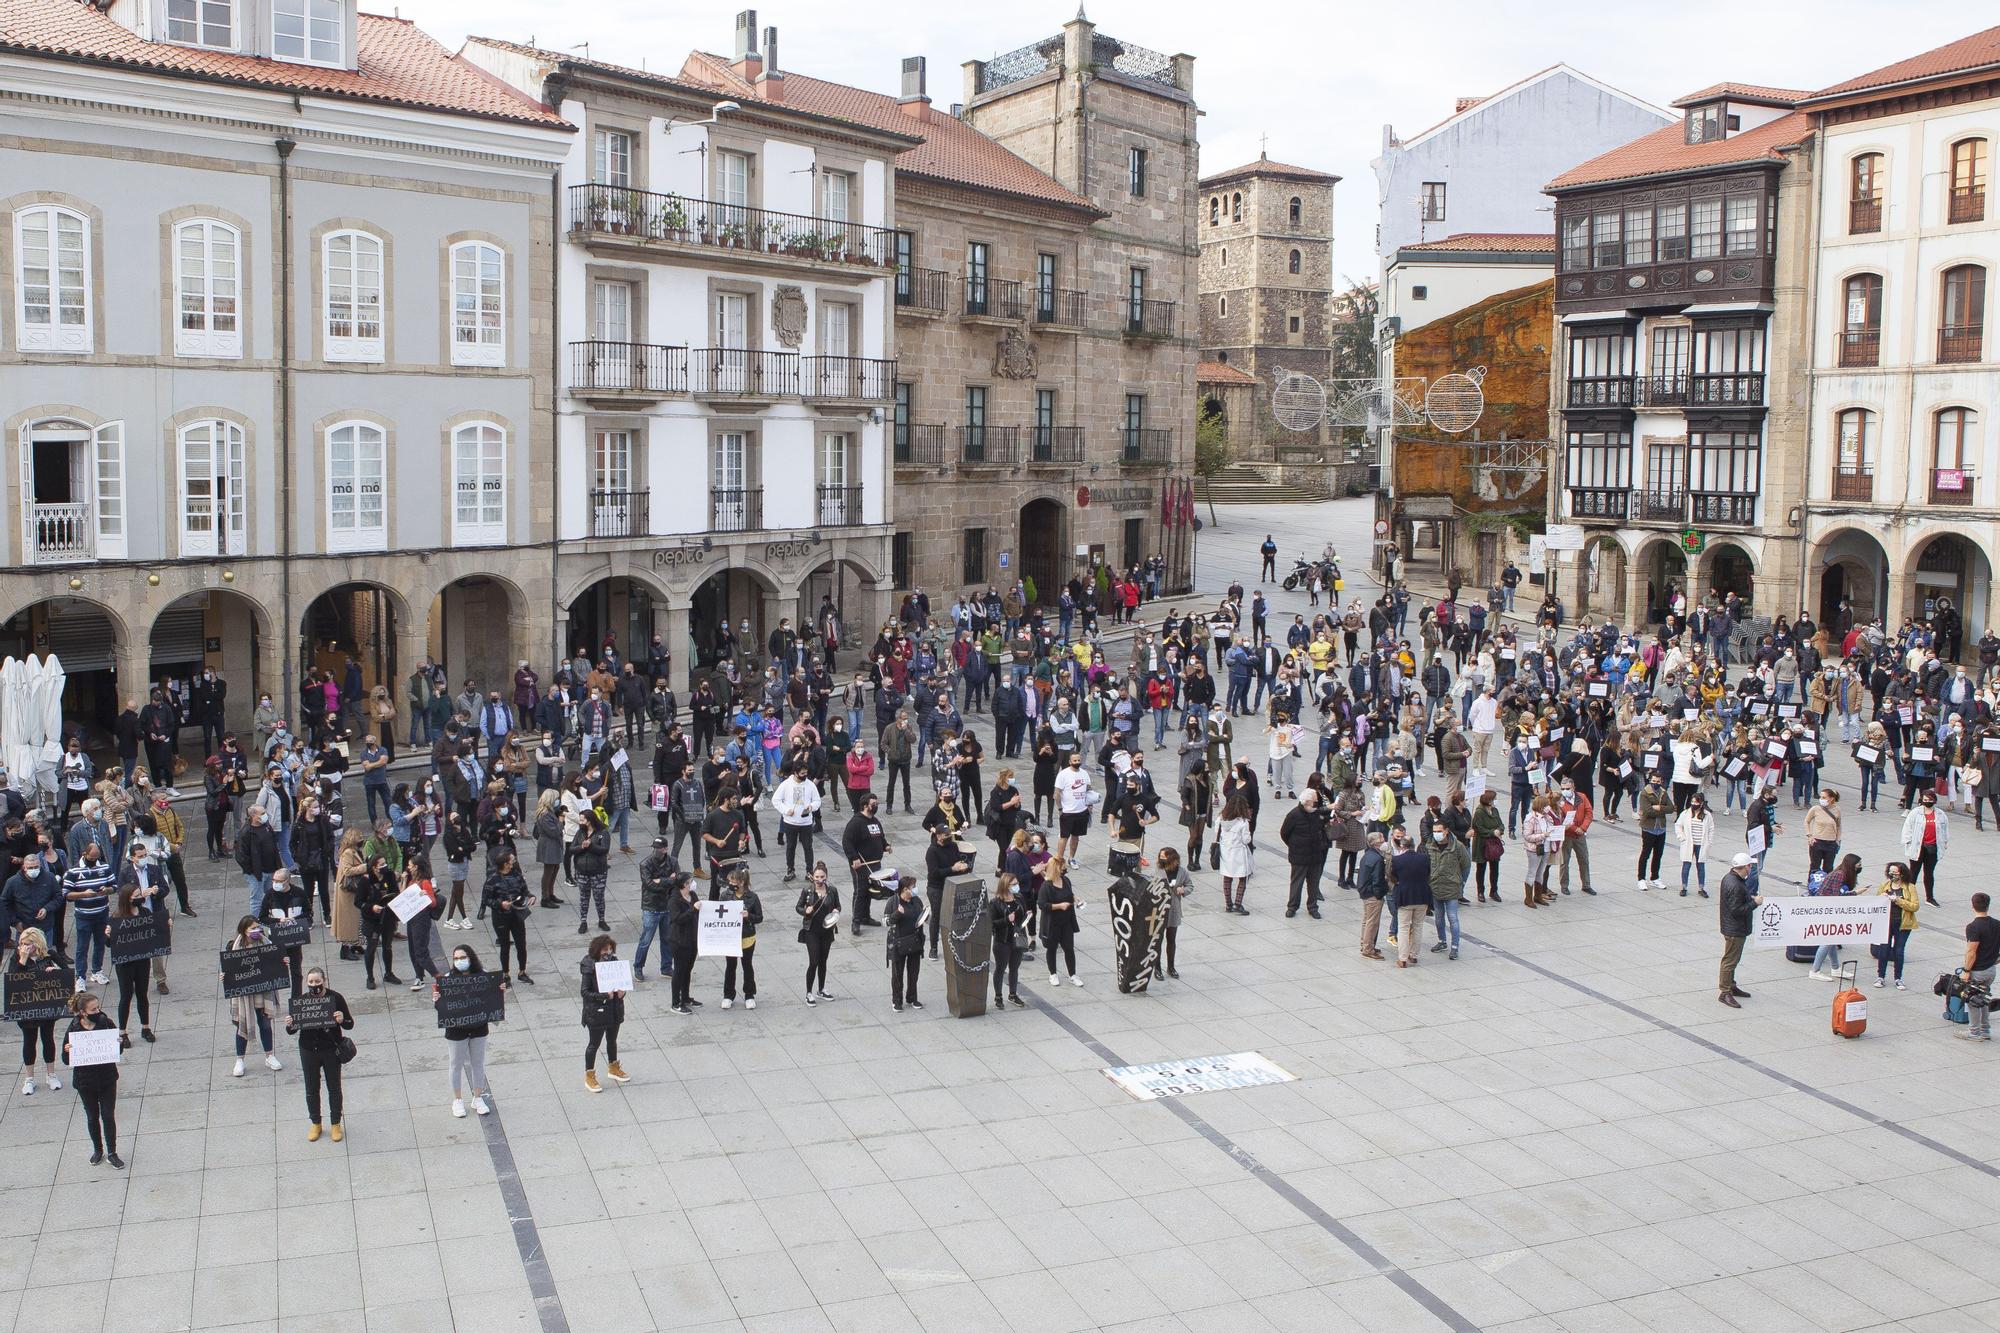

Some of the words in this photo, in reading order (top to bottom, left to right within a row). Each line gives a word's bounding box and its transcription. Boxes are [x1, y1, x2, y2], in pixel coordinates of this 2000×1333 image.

[654, 545, 705, 569] pepito
[767, 541, 810, 561] pepito
[1791, 907, 1823, 915] AGENCIAS
[1824, 907, 1833, 915] DE
[1835, 907, 1857, 915] VIAJES
[120, 915, 153, 929] AYUDAS
[1111, 892, 1134, 958] SOS
[116, 928, 157, 944] ALQUILER
[1803, 923, 1852, 939] ¡AYUDAS
[1855, 922, 1873, 935] YA!
[241, 956, 260, 966] AGUA
[6, 972, 36, 981] TODOS
[235, 969, 261, 981] BASURA
[33, 980, 62, 990] SOMOS
[10, 988, 71, 1005] ESENCIALES
[293, 1011, 330, 1020] TERRAZAS
[1150, 1083, 1204, 1097] SOS
